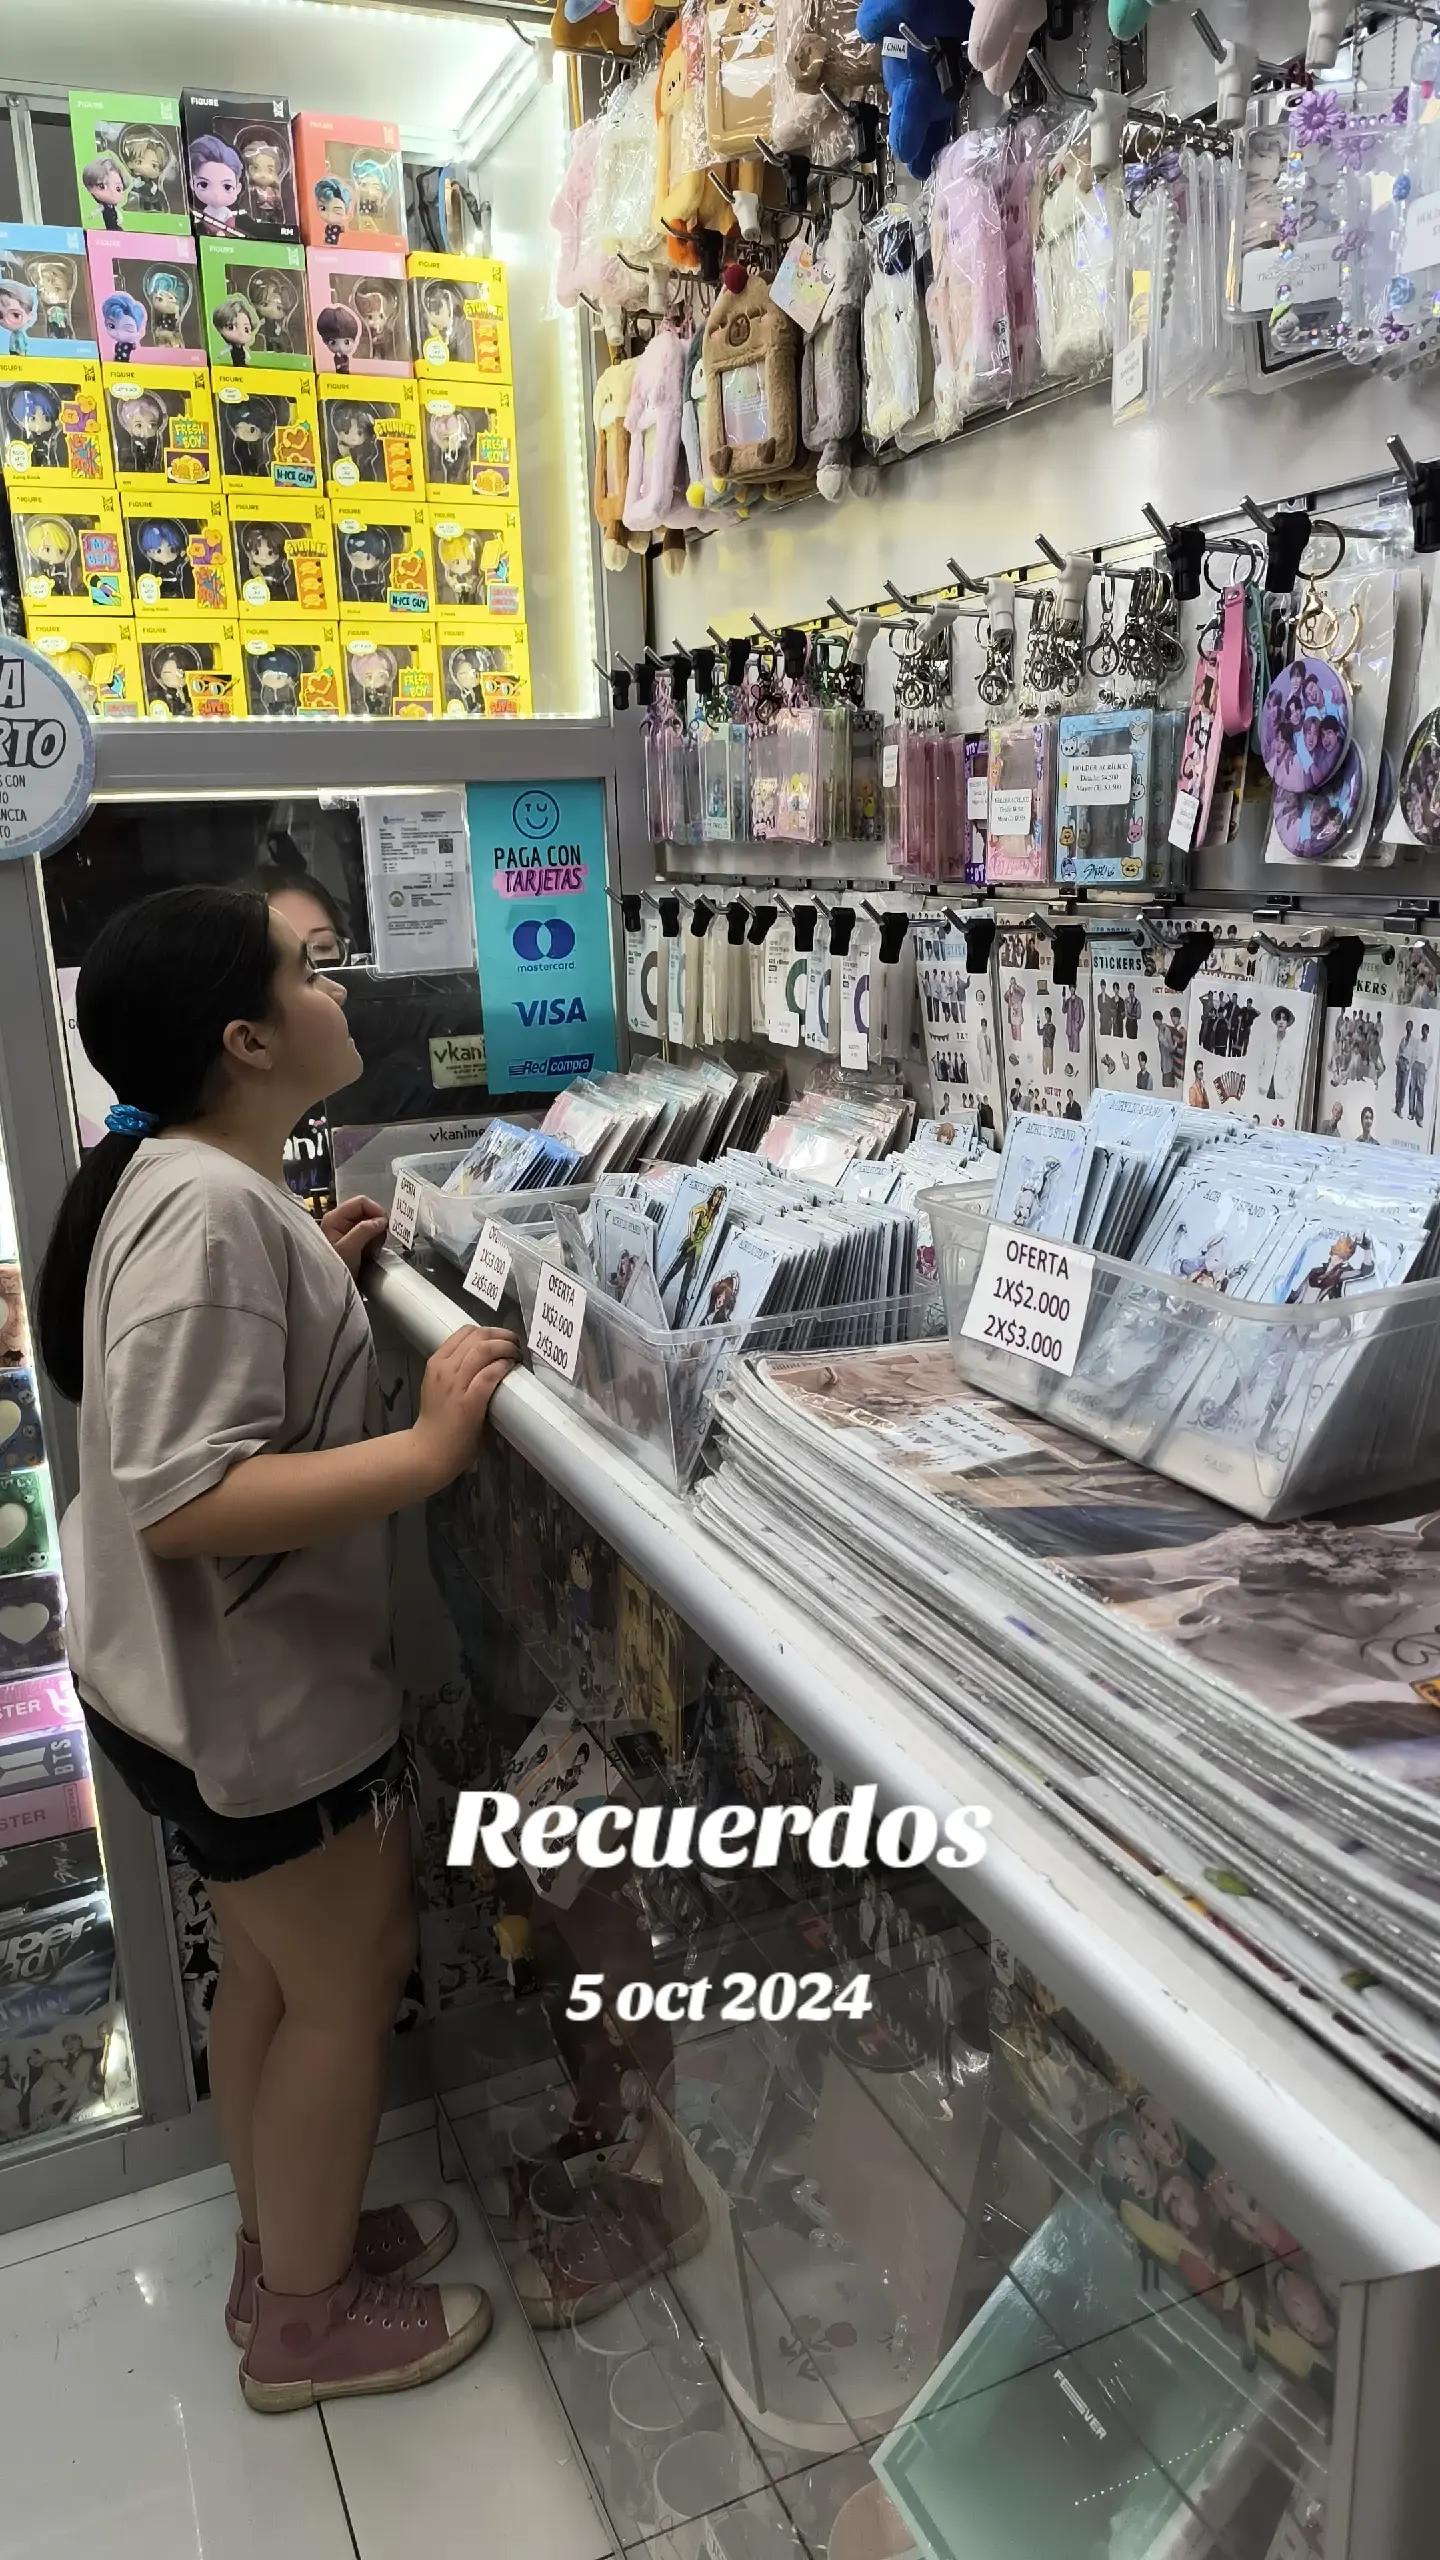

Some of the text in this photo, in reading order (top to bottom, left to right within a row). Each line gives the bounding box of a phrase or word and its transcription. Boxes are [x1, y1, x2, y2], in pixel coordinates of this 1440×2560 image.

[190, 96, 220, 108] FIGURE
[281, 227, 294, 236] RM
[418, 261, 440, 270] FIGURE
[110, 371, 136, 379] FIGURE
[219, 375, 244, 384] FIGURE
[326, 382, 350, 391] FIGURE
[175, 423, 205, 438] FRESH
[182, 436, 204, 449] BOY
[481, 438, 508, 451] FRESH
[487, 450, 505, 463] BOY
[276, 468, 314, 485] N-ICE GUY
[338, 507, 361, 515] FIGURE
[393, 594, 427, 608] N-ICE GUY
[35, 626, 60, 634] FIGURE
[142, 626, 167, 634] FIGURE
[347, 629, 370, 637] FIGURE
[404, 676, 430, 688] FRESH
[410, 685, 429, 697] BOY
[4, 774, 27, 789] CON
[494, 844, 581, 870] PAGA CON
[504, 867, 583, 896] TARJETAS
[517, 961, 575, 973] mastercard
[1093, 954, 1143, 972] STICKERS
[1356, 979, 1388, 997] KERS
[512, 997, 588, 1027] VISA
[433, 1039, 487, 1065] vkani
[429, 1124, 486, 1144] vkanime
[1006, 1239, 1069, 1280] OFERTA
[548, 1273, 576, 1308] OFERTA
[993, 1276, 1070, 1322] 1X$2.000
[541, 1301, 574, 1340] 1X$2.000
[983, 1314, 1062, 1362] 2X$3.000
[535, 1330, 568, 1370] 2X$3.000
[50, 1736, 76, 1778] BTS
